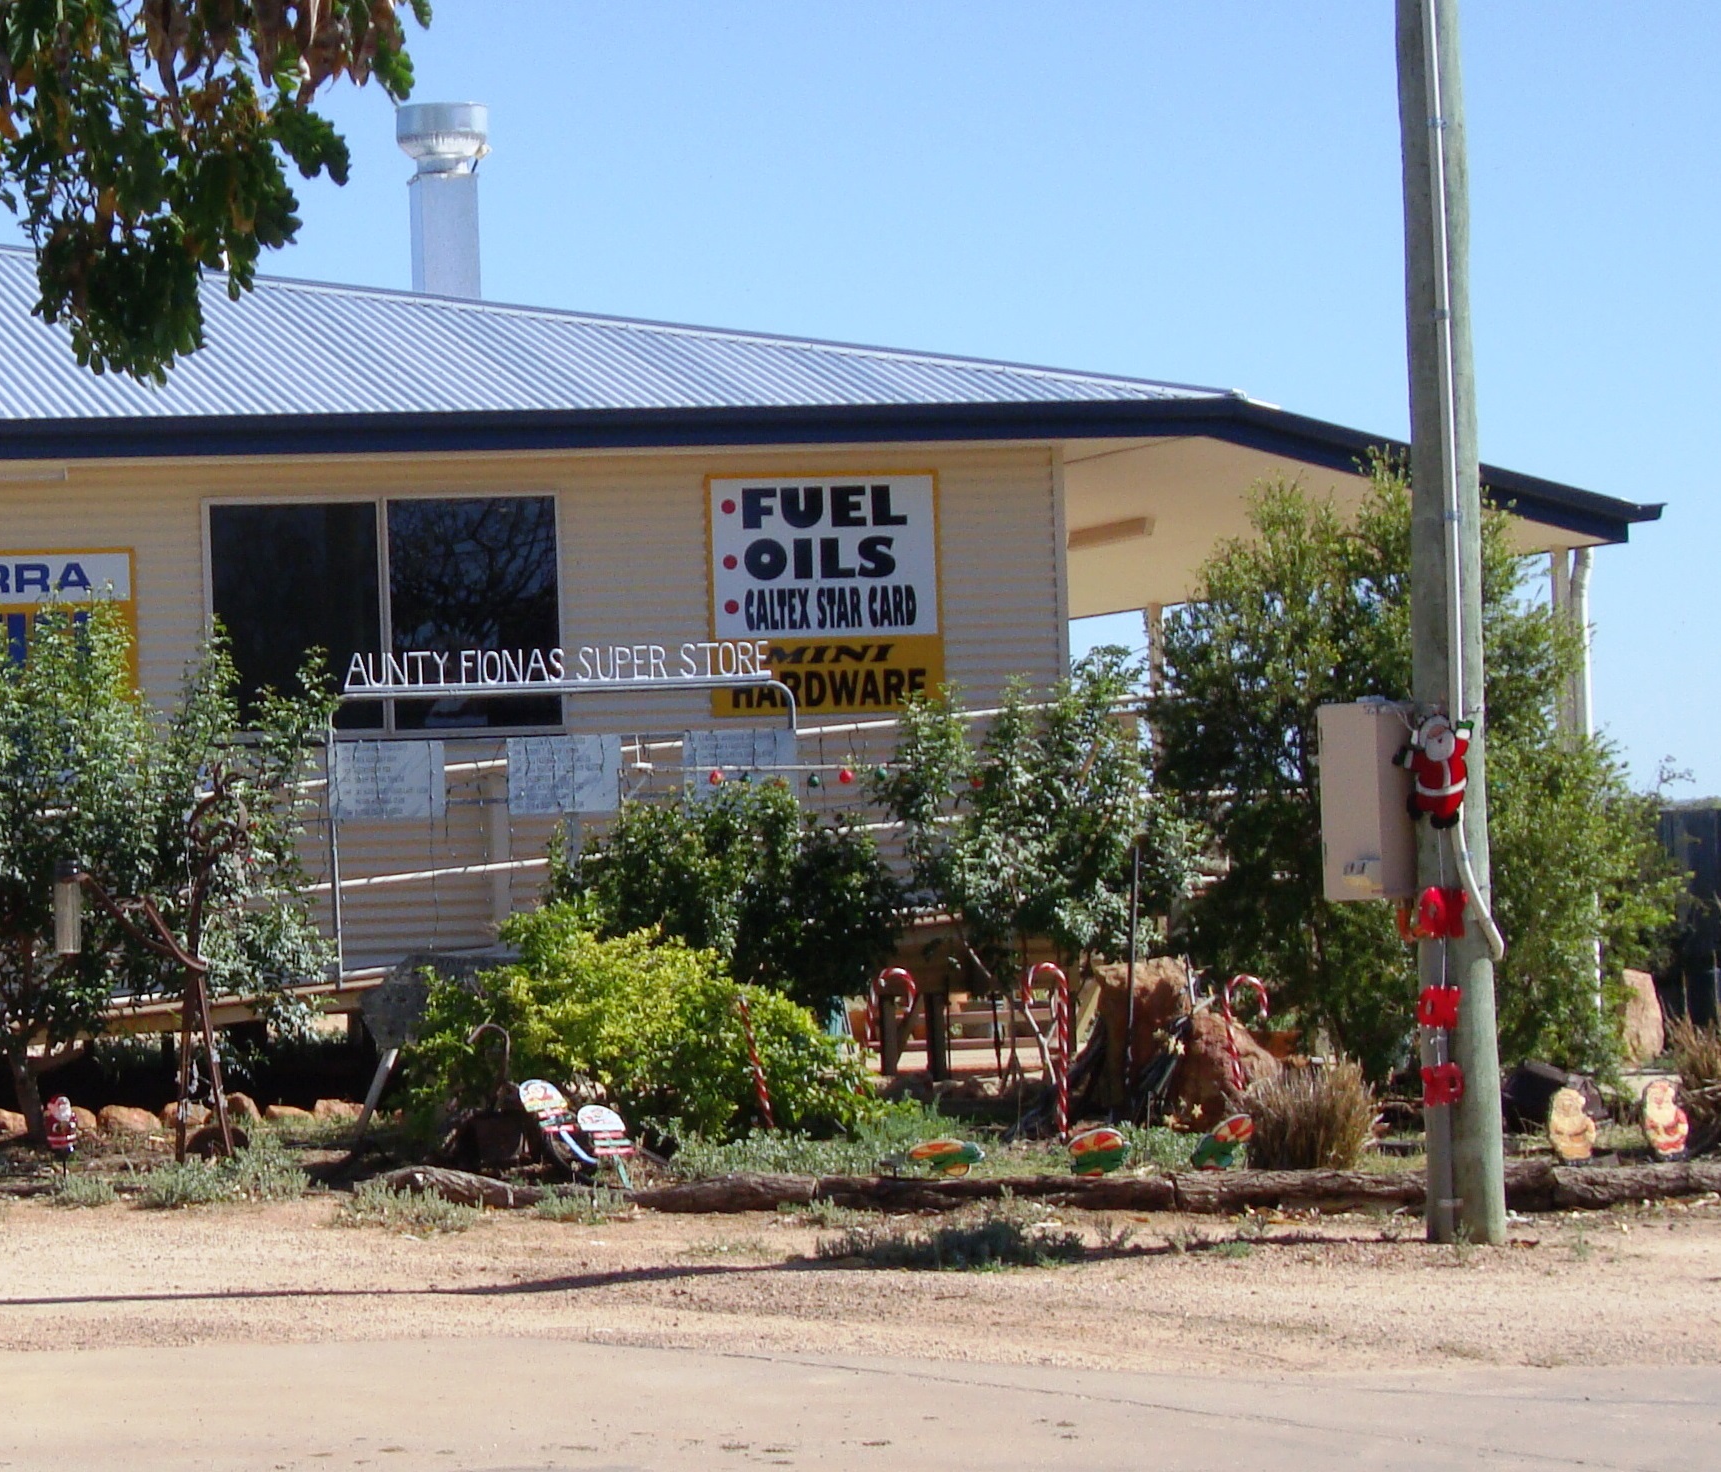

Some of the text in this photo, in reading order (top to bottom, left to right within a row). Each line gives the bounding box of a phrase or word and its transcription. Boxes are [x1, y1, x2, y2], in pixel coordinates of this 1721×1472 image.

[742, 485, 907, 530] FUEL
[744, 536, 896, 581] OILS
[745, 584, 917, 631] CALTEX STAR CARD
[345, 640, 769, 687] AUNTY FIONAS SUPER STORE
[762, 643, 895, 664] MINI
